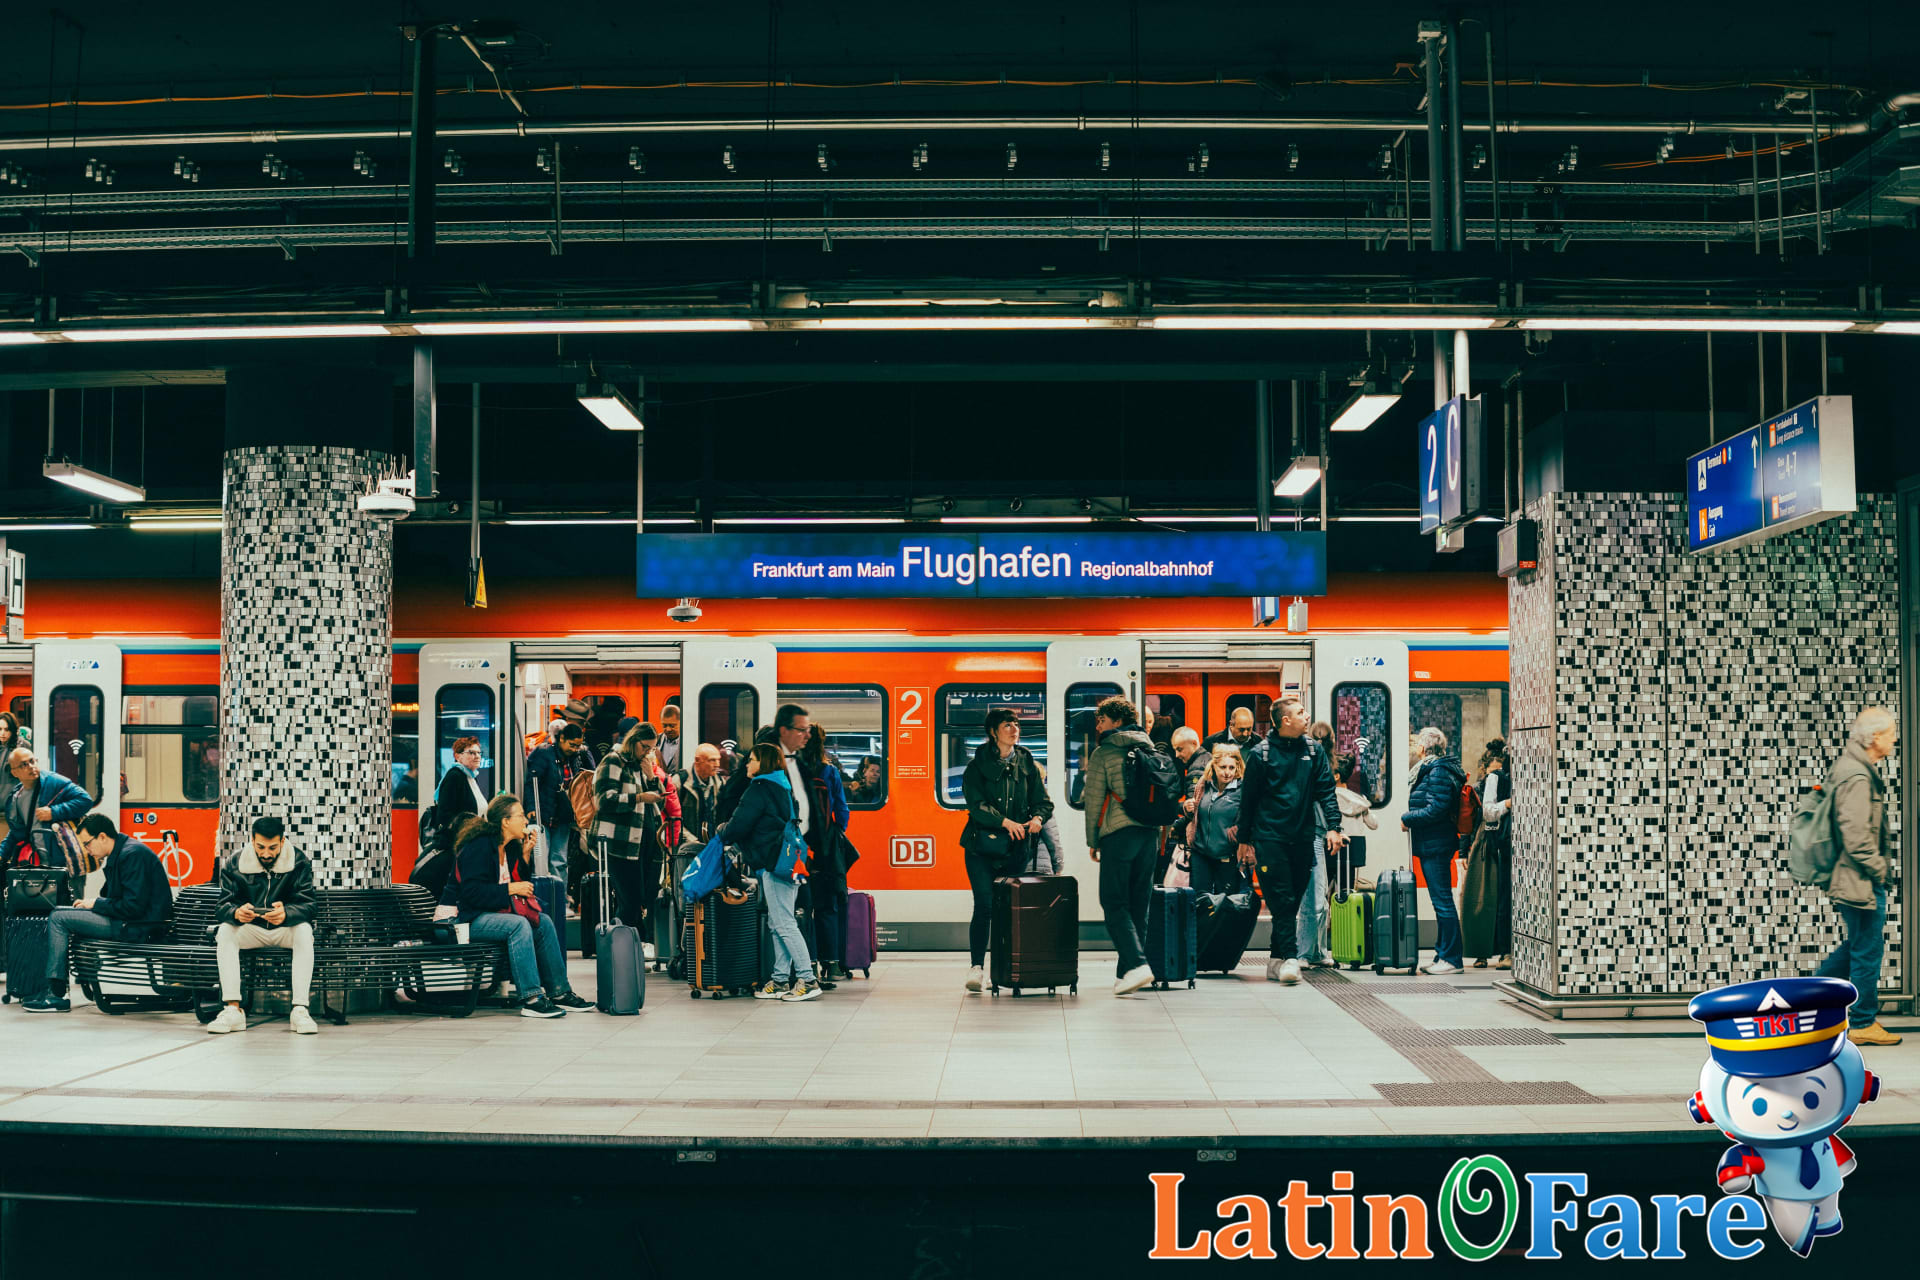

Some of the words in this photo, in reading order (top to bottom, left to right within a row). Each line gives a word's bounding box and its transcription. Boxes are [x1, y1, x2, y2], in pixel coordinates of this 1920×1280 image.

[1543, 186, 1554, 194] SV
[1427, 424, 1439, 503] 2
[1446, 403, 1459, 491] C
[1706, 450, 1722, 470] Terminal
[754, 563, 825, 578] Frankfurt
[827, 566, 853, 578] am
[857, 562, 896, 578] Main
[903, 546, 1072, 586] Flughafen
[1080, 561, 1214, 581] Regionalbahnhof
[900, 690, 923, 725] 2
[895, 840, 930, 862] DB
